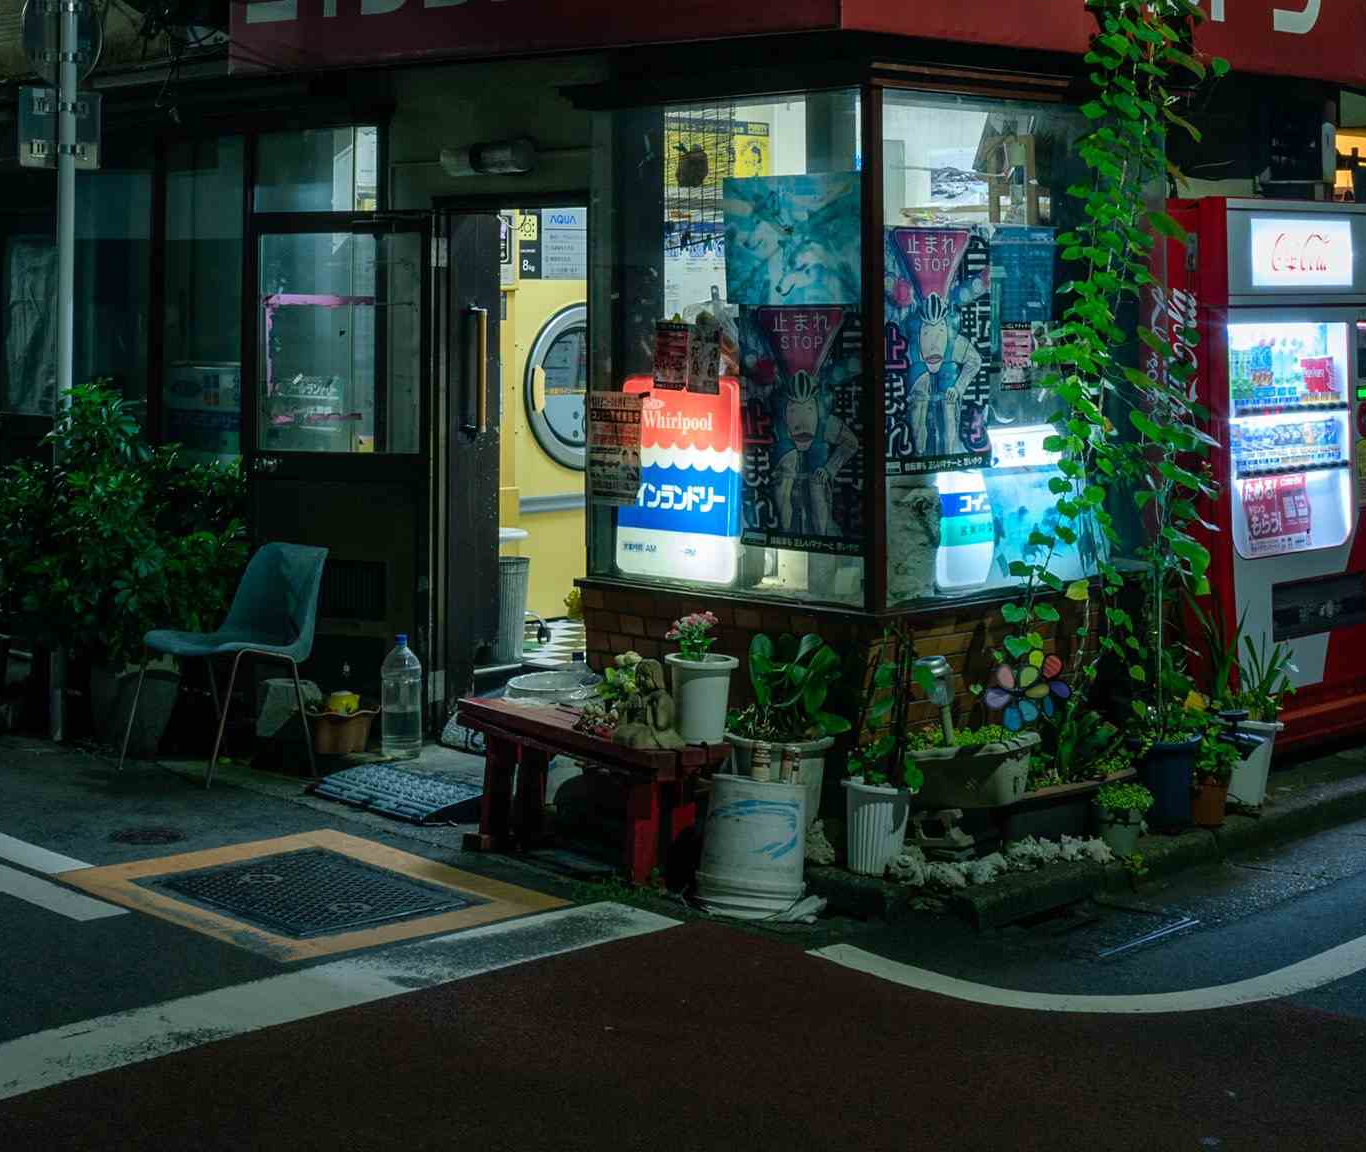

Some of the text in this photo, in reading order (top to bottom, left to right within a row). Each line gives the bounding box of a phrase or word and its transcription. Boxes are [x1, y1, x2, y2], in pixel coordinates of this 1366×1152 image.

[549, 214, 577, 225] AQUA
[907, 234, 956, 254] 止まれ
[914, 257, 951, 272] STOP
[771, 311, 832, 333] 止まれ
[780, 335, 825, 351] STOP
[643, 409, 714, 435] Whirlpool
[636, 482, 726, 514] インランドリー
